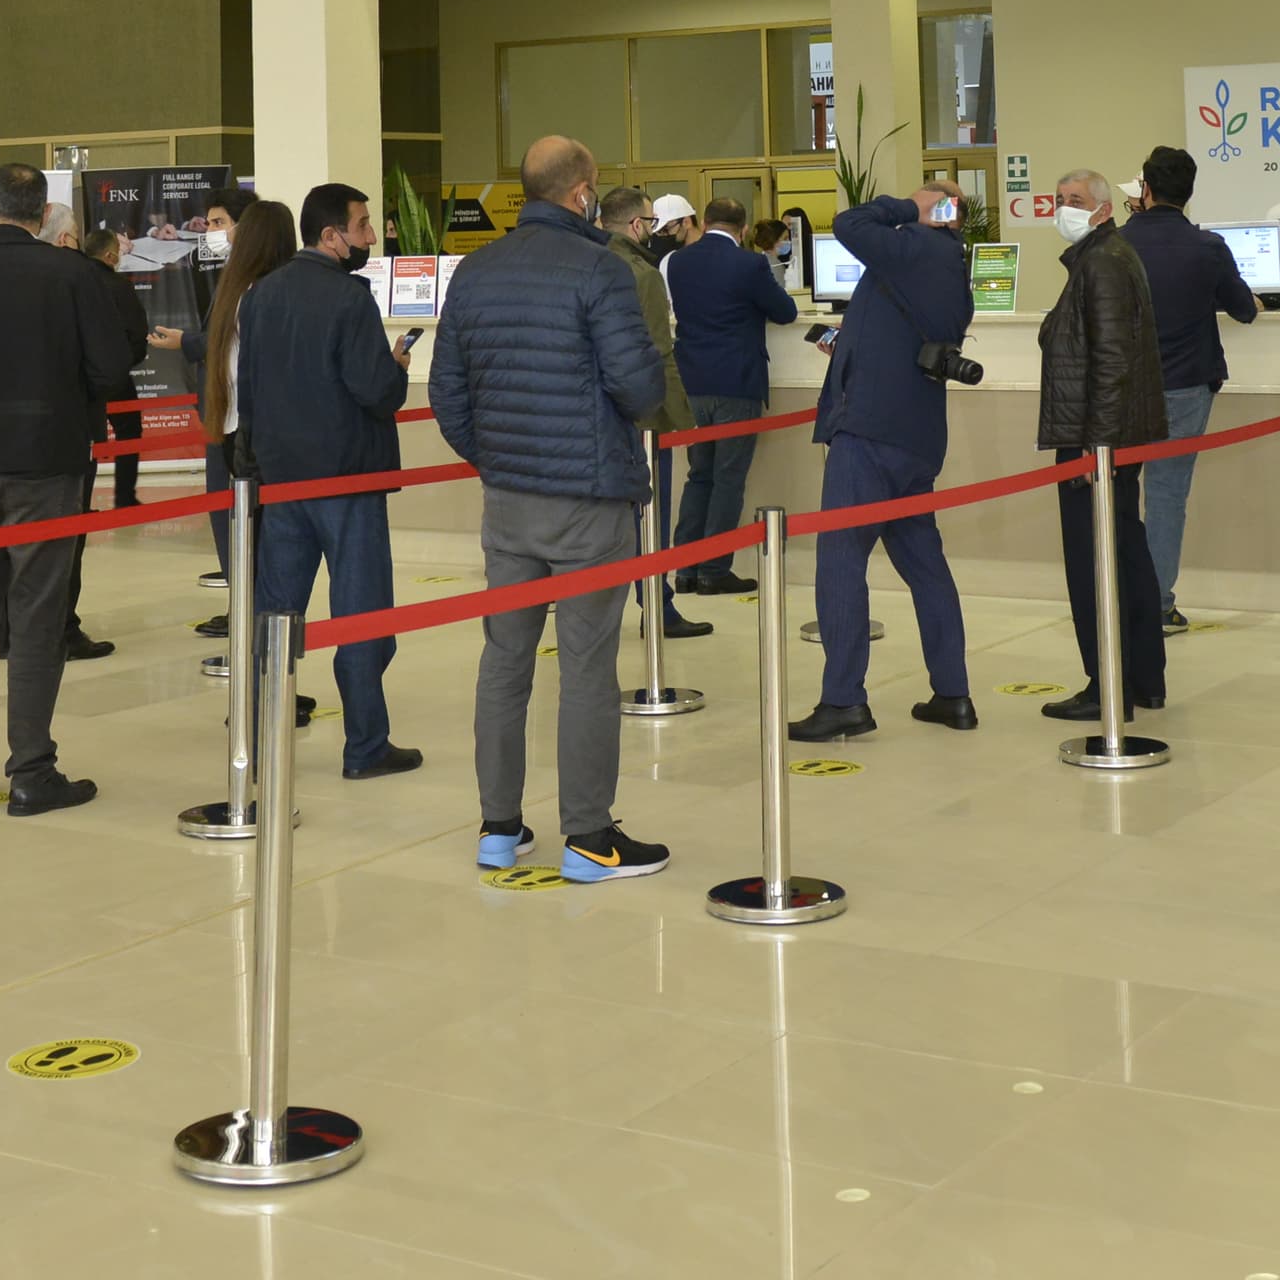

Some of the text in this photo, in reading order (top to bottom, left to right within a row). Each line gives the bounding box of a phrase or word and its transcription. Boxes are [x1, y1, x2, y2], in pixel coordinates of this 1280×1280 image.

[1264, 162, 1278, 172] 20
[163, 181, 211, 190] CORPORATE LEGAL
[1008, 183, 1020, 191] First
[110, 189, 139, 202] FNK
